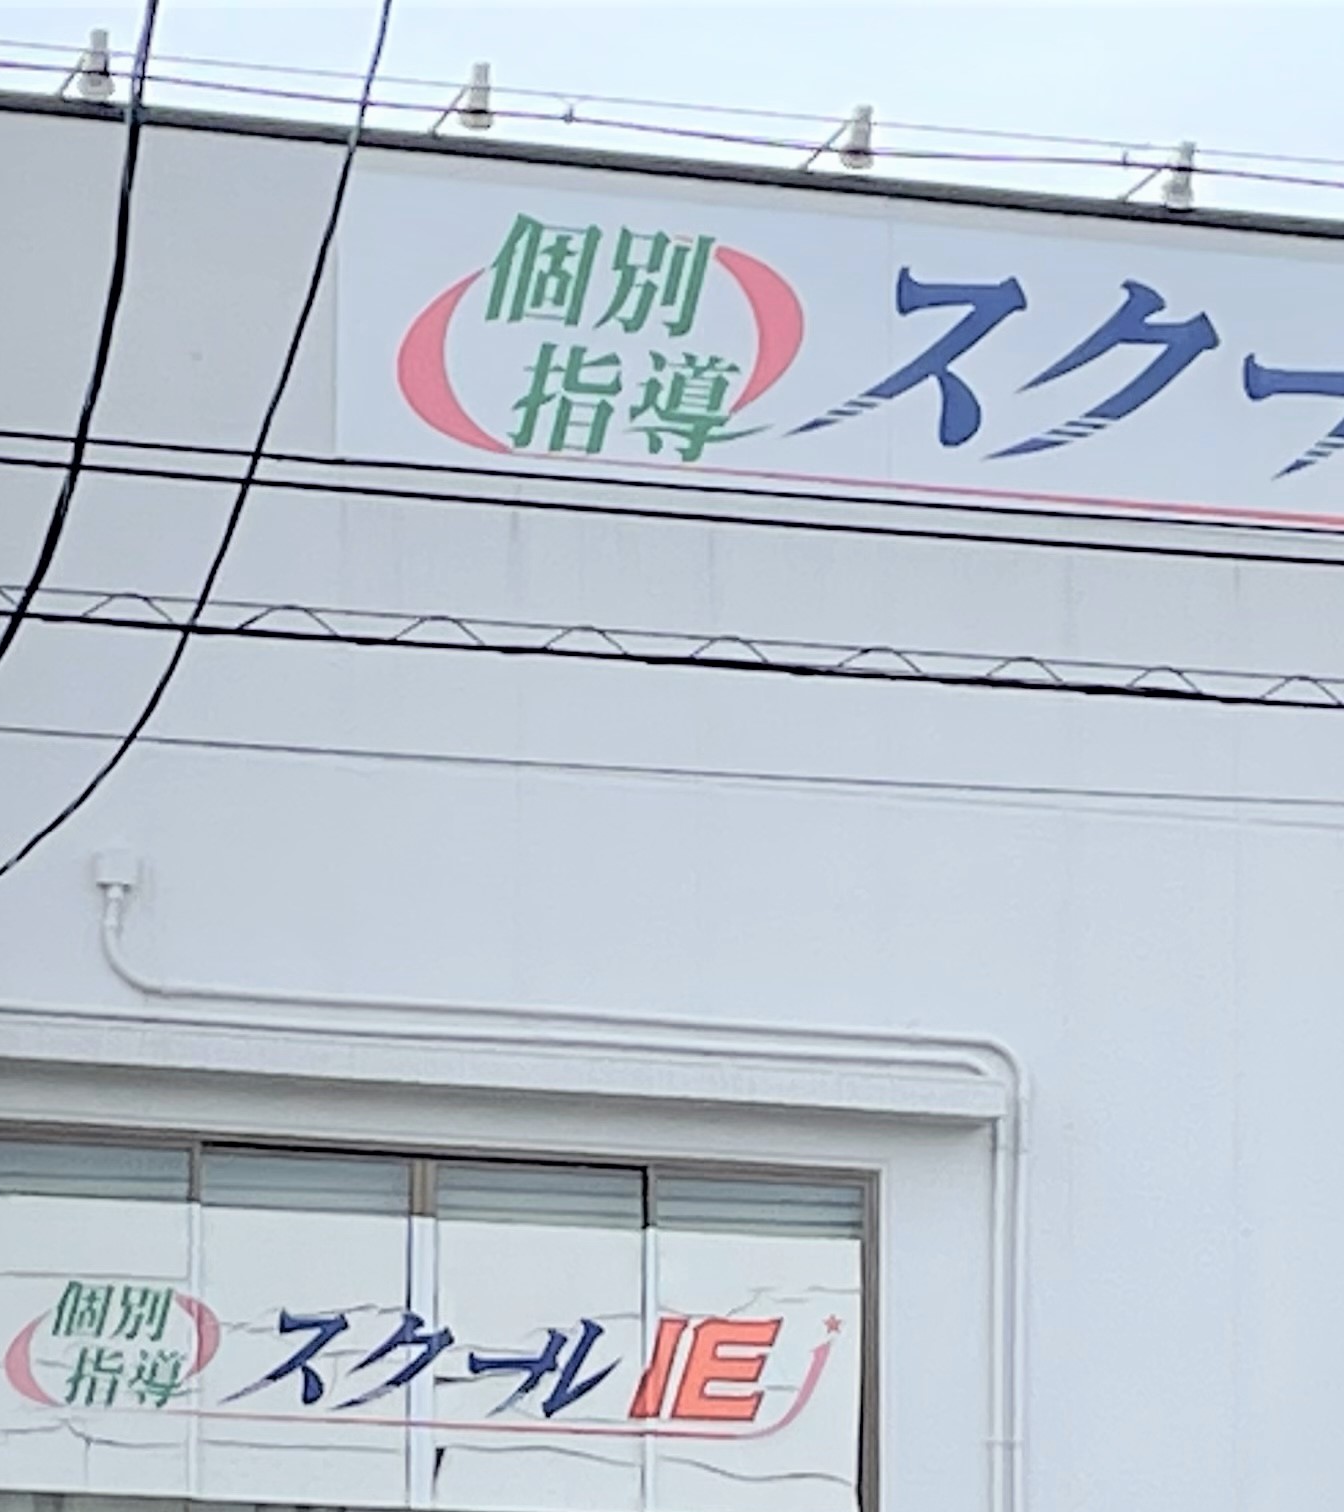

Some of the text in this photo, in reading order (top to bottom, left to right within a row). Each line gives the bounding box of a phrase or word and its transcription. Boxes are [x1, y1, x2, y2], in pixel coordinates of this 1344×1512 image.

[485, 212, 715, 336] 個別
[509, 343, 744, 463] 指導
[53, 1280, 174, 1340] 個別
[64, 1348, 189, 1408] 指導
